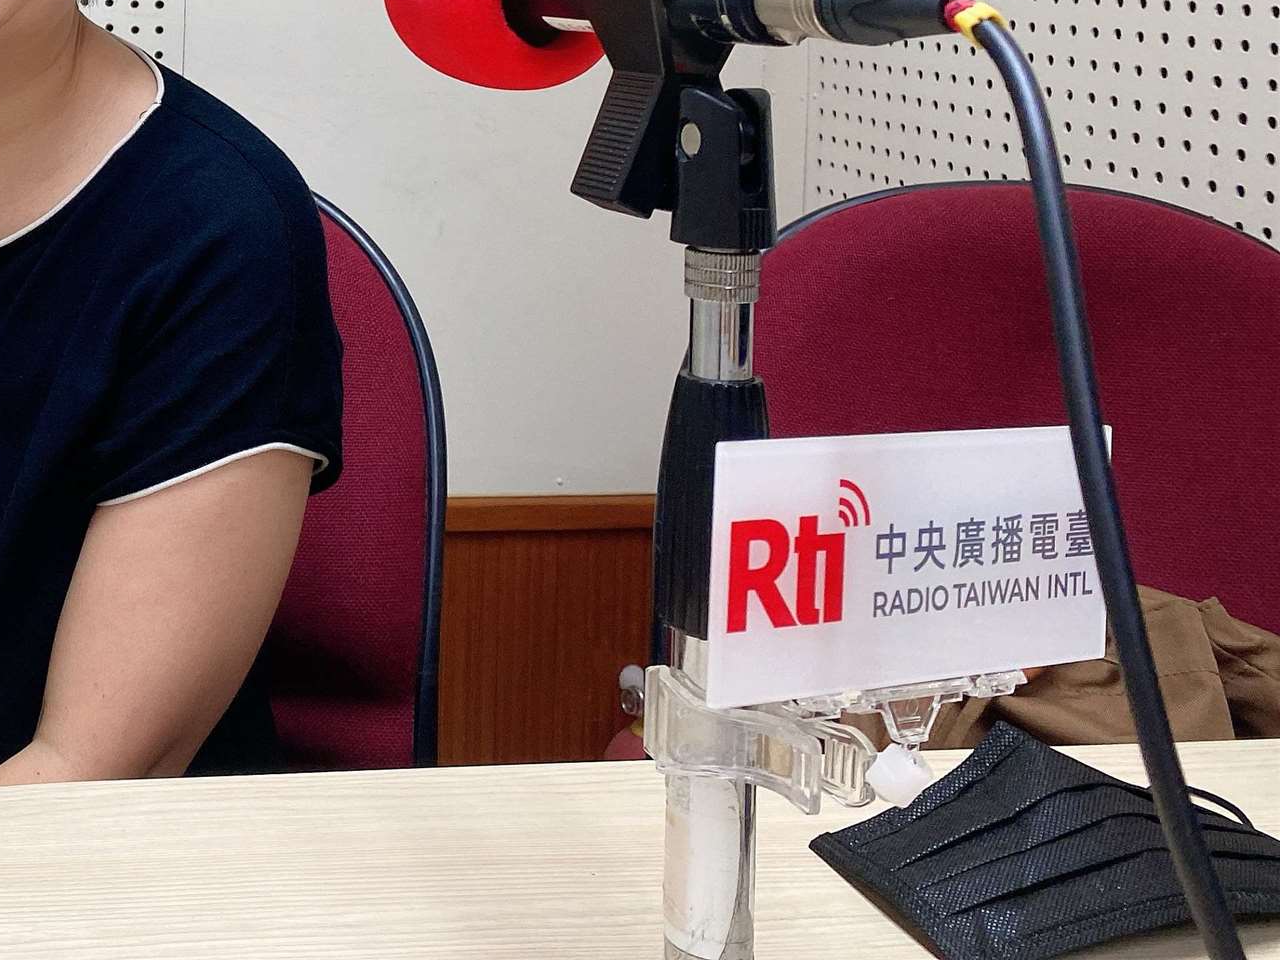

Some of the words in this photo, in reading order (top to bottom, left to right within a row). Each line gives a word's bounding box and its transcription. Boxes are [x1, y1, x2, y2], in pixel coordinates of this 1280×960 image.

[726, 515, 846, 634] Rti
[875, 509, 1094, 575] 中央廣播電臺
[872, 584, 949, 618] RADIO
[952, 575, 1040, 609] TAIWAN
[1047, 571, 1093, 599] INTL
